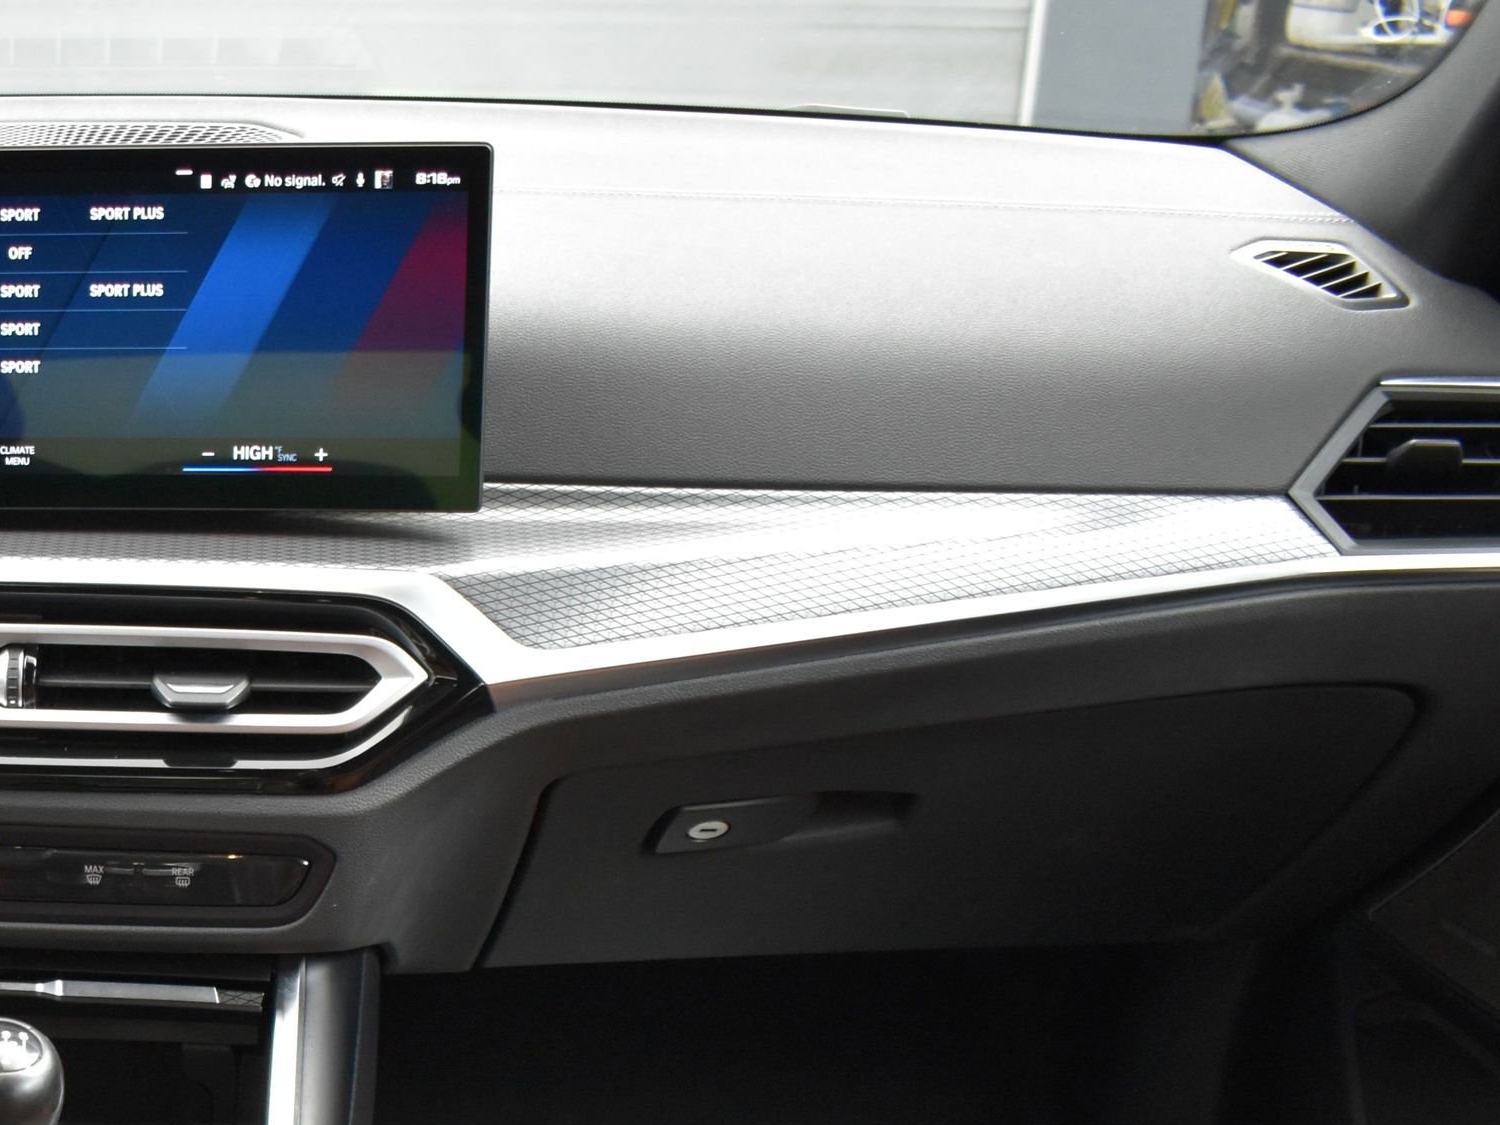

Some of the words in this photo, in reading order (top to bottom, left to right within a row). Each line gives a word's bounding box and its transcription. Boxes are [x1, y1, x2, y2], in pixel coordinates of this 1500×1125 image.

[264, 175, 283, 187] No
[284, 174, 326, 190] signal.
[0, 208, 40, 222] SPORT
[90, 207, 129, 221] SPORT
[132, 206, 165, 220] PLUS
[7, 246, 33, 260] OFF
[0, 284, 40, 299] SPORT
[90, 284, 129, 298] SPORT
[132, 283, 164, 297] PLUS
[0, 322, 40, 336] SPORT
[0, 360, 40, 374] SPORT
[0, 445, 36, 455] CLIMATE
[232, 445, 274, 461] HIGH
[5, 456, 30, 466] MENU
[277, 453, 298, 462] SYNC
[84, 865, 105, 875] MAX
[171, 867, 195, 877] REAR
